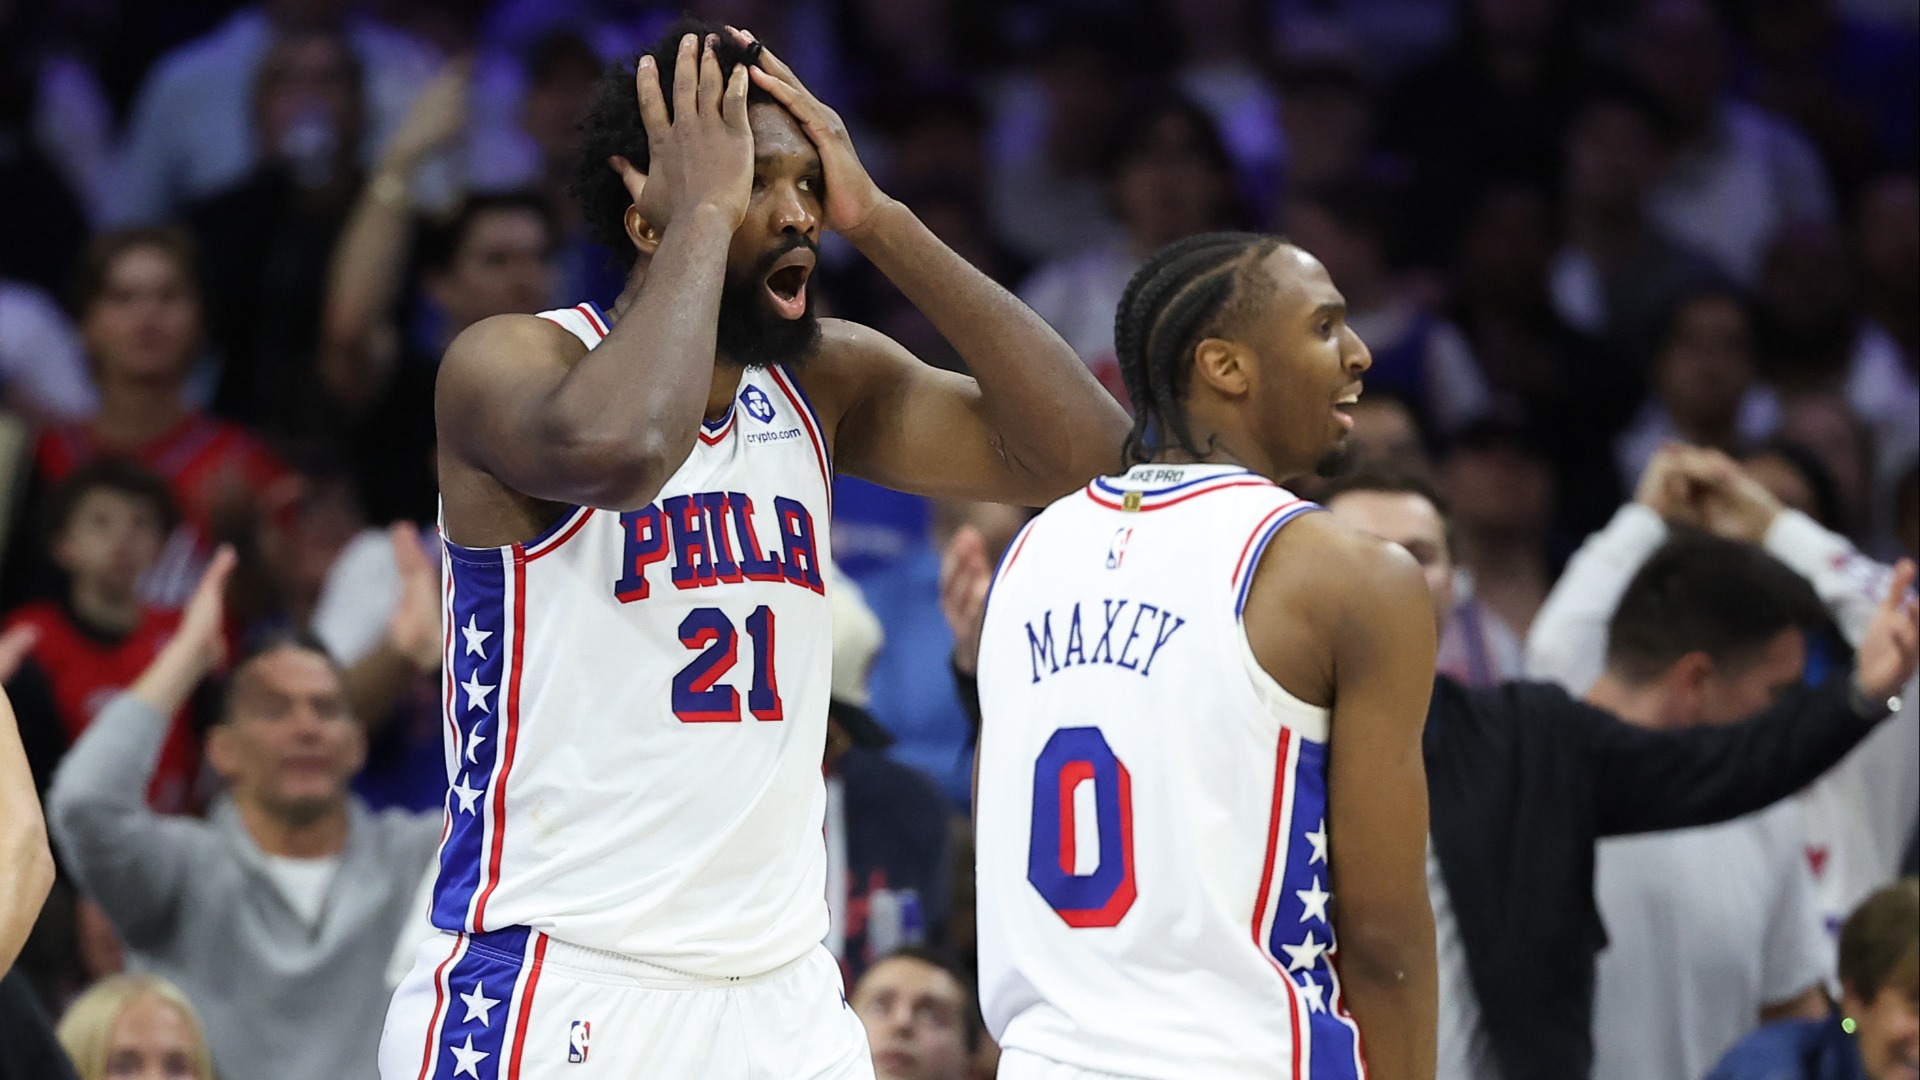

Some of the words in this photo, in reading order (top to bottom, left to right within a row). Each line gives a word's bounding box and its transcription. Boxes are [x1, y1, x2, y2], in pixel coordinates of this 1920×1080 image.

[746, 427, 802, 443] crypto.com
[1154, 469, 1185, 482] PRO
[614, 491, 825, 604] PHILA
[671, 605, 784, 723] 21
[1025, 599, 1185, 684] MAXEY
[1027, 726, 1138, 929] 0
